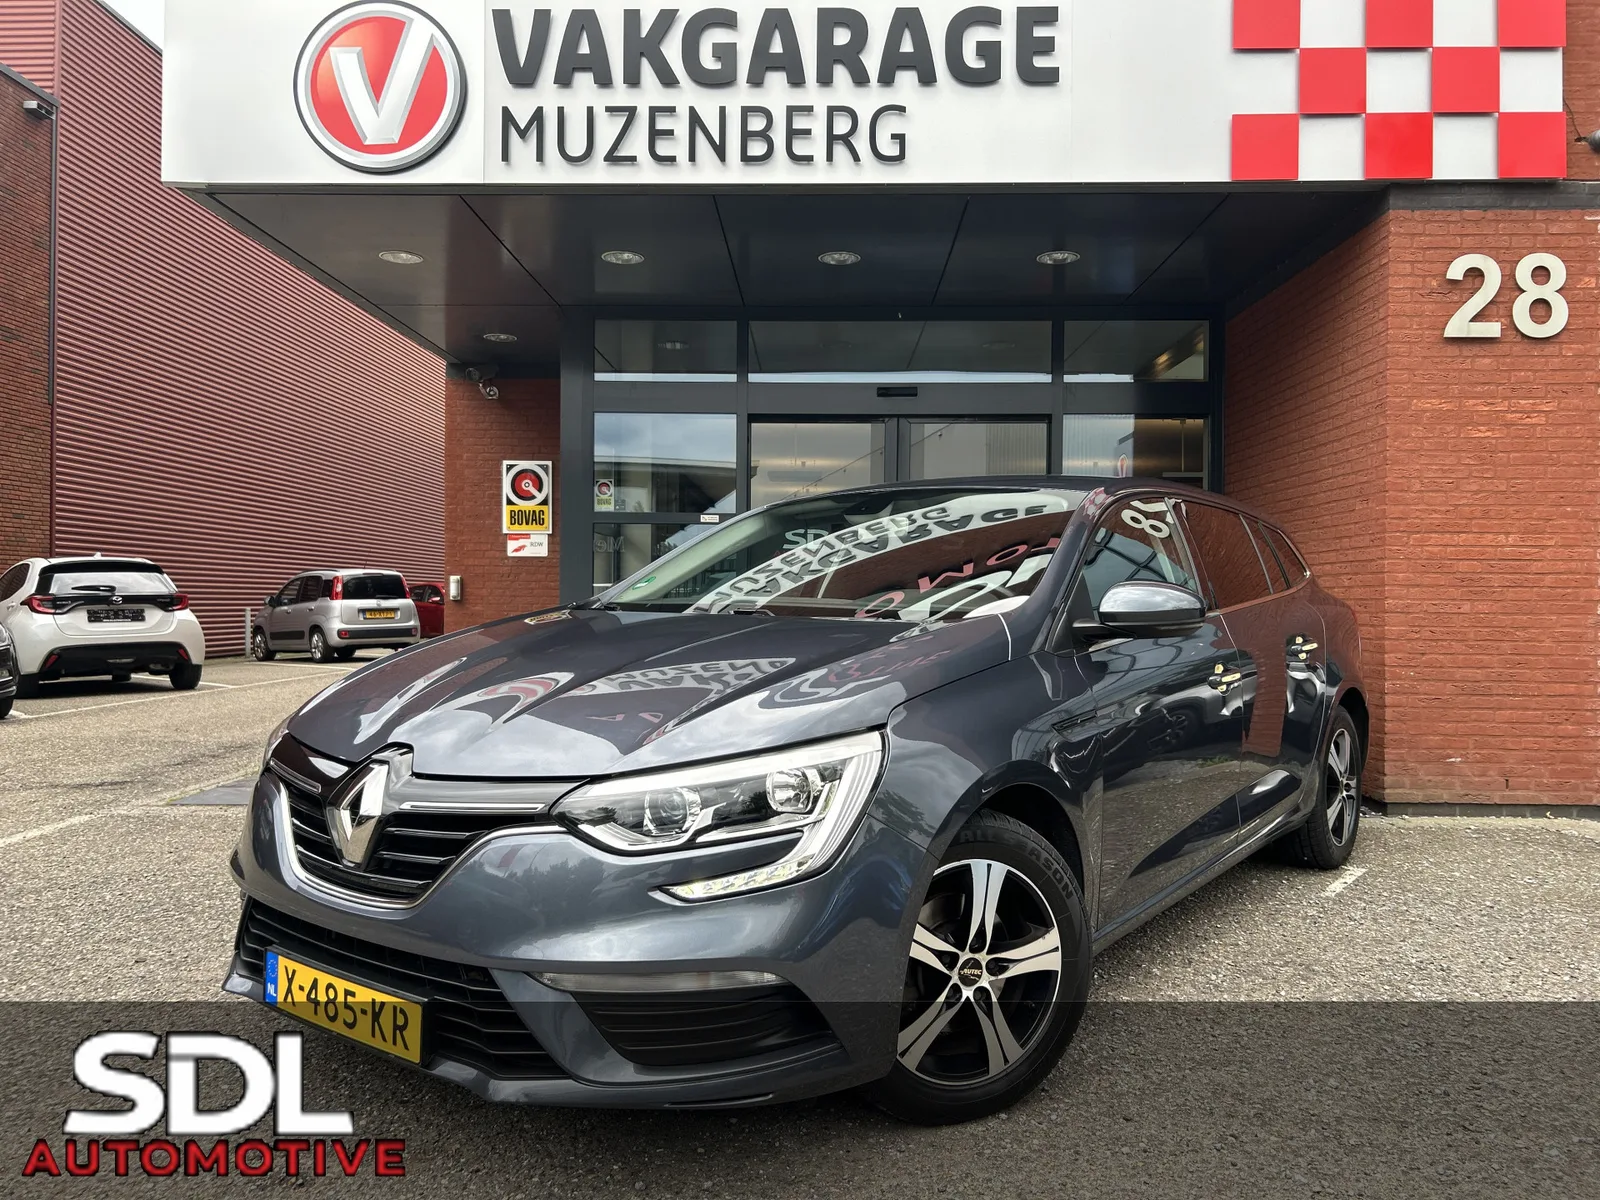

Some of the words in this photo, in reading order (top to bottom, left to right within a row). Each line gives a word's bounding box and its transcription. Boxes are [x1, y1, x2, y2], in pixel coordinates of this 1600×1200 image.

[492, 6, 1060, 86] VAKGARAGE
[501, 104, 907, 163] MUZENBERG
[1444, 252, 1569, 338] 28
[509, 509, 545, 526] BOVAG
[267, 982, 277, 997] NL
[283, 964, 410, 1051] X-485-KR
